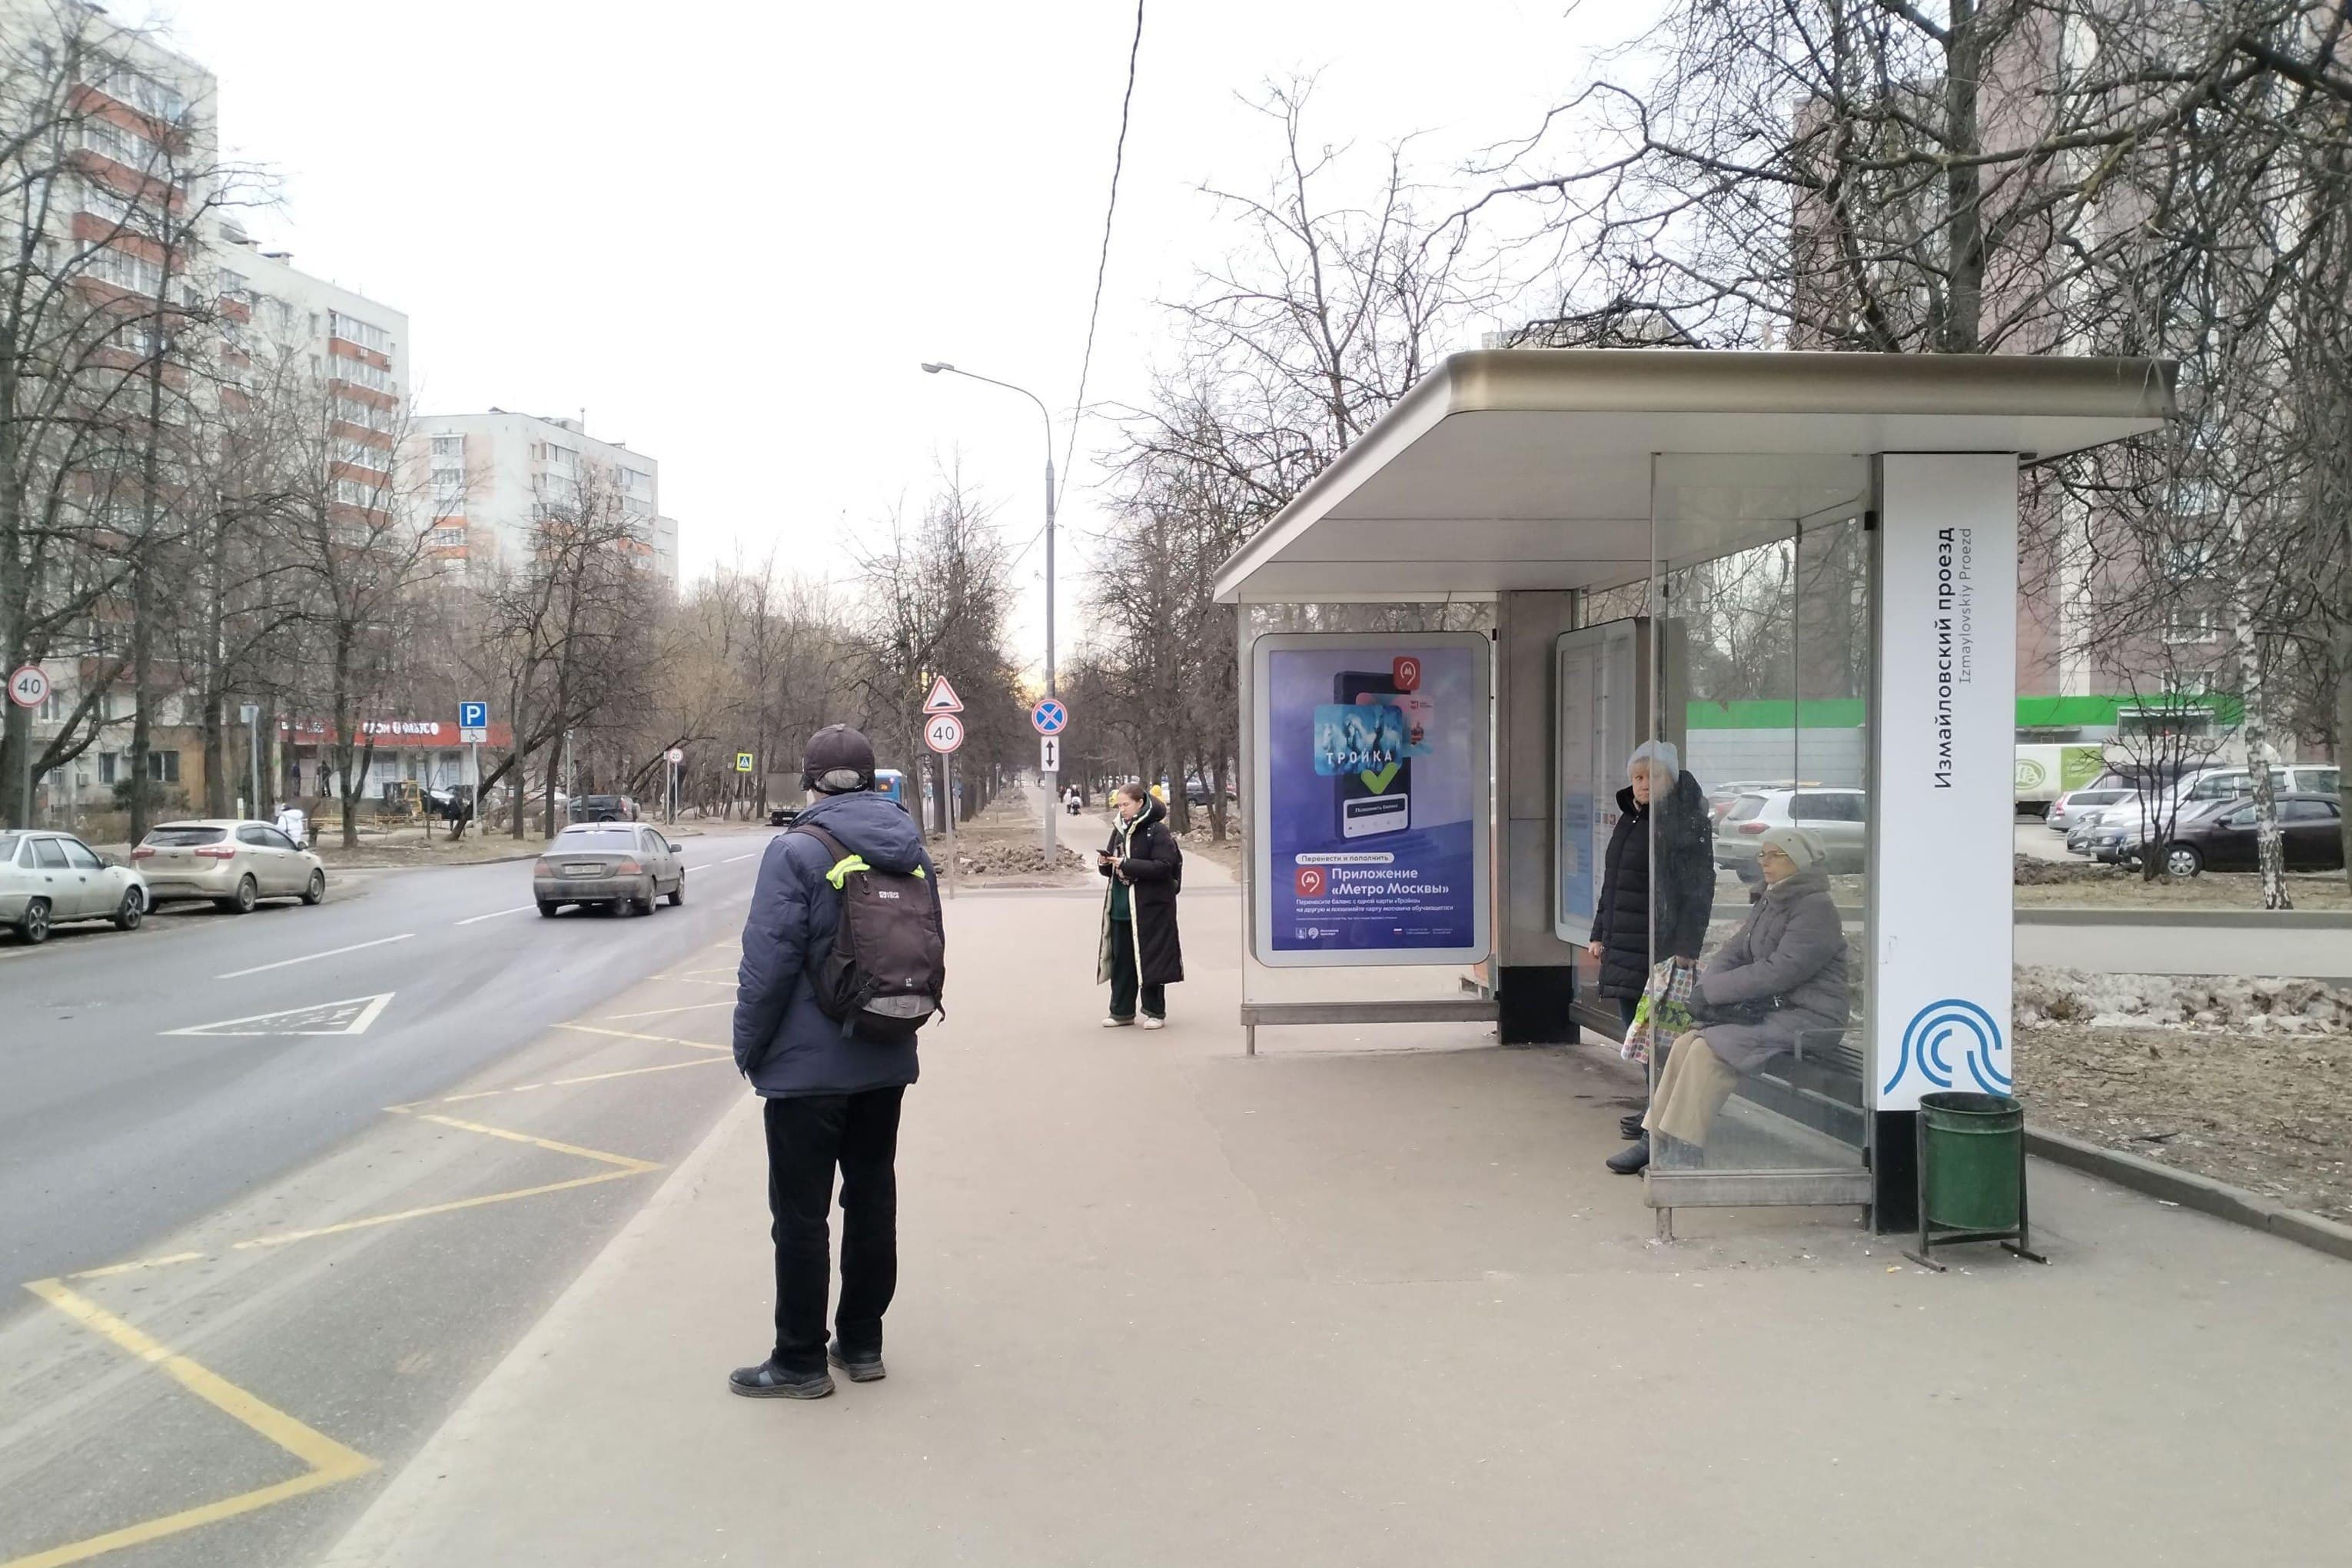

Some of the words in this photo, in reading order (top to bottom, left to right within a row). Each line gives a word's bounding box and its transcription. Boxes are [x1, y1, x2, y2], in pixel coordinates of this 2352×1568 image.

[1958, 528, 1972, 580] Proezd
[1938, 527, 1955, 610] проезд
[1958, 584, 1974, 683] Izmaylovskiy
[18, 678, 41, 694] 40
[1934, 618, 1952, 788] Измайловский
[467, 705, 481, 725] P
[933, 726, 954, 740] 40
[1326, 748, 1392, 765] ТРОЙКА
[1332, 868, 1418, 882] Приложение
[1331, 883, 1384, 896] «Метро
[1387, 882, 1450, 894] Москвы»
